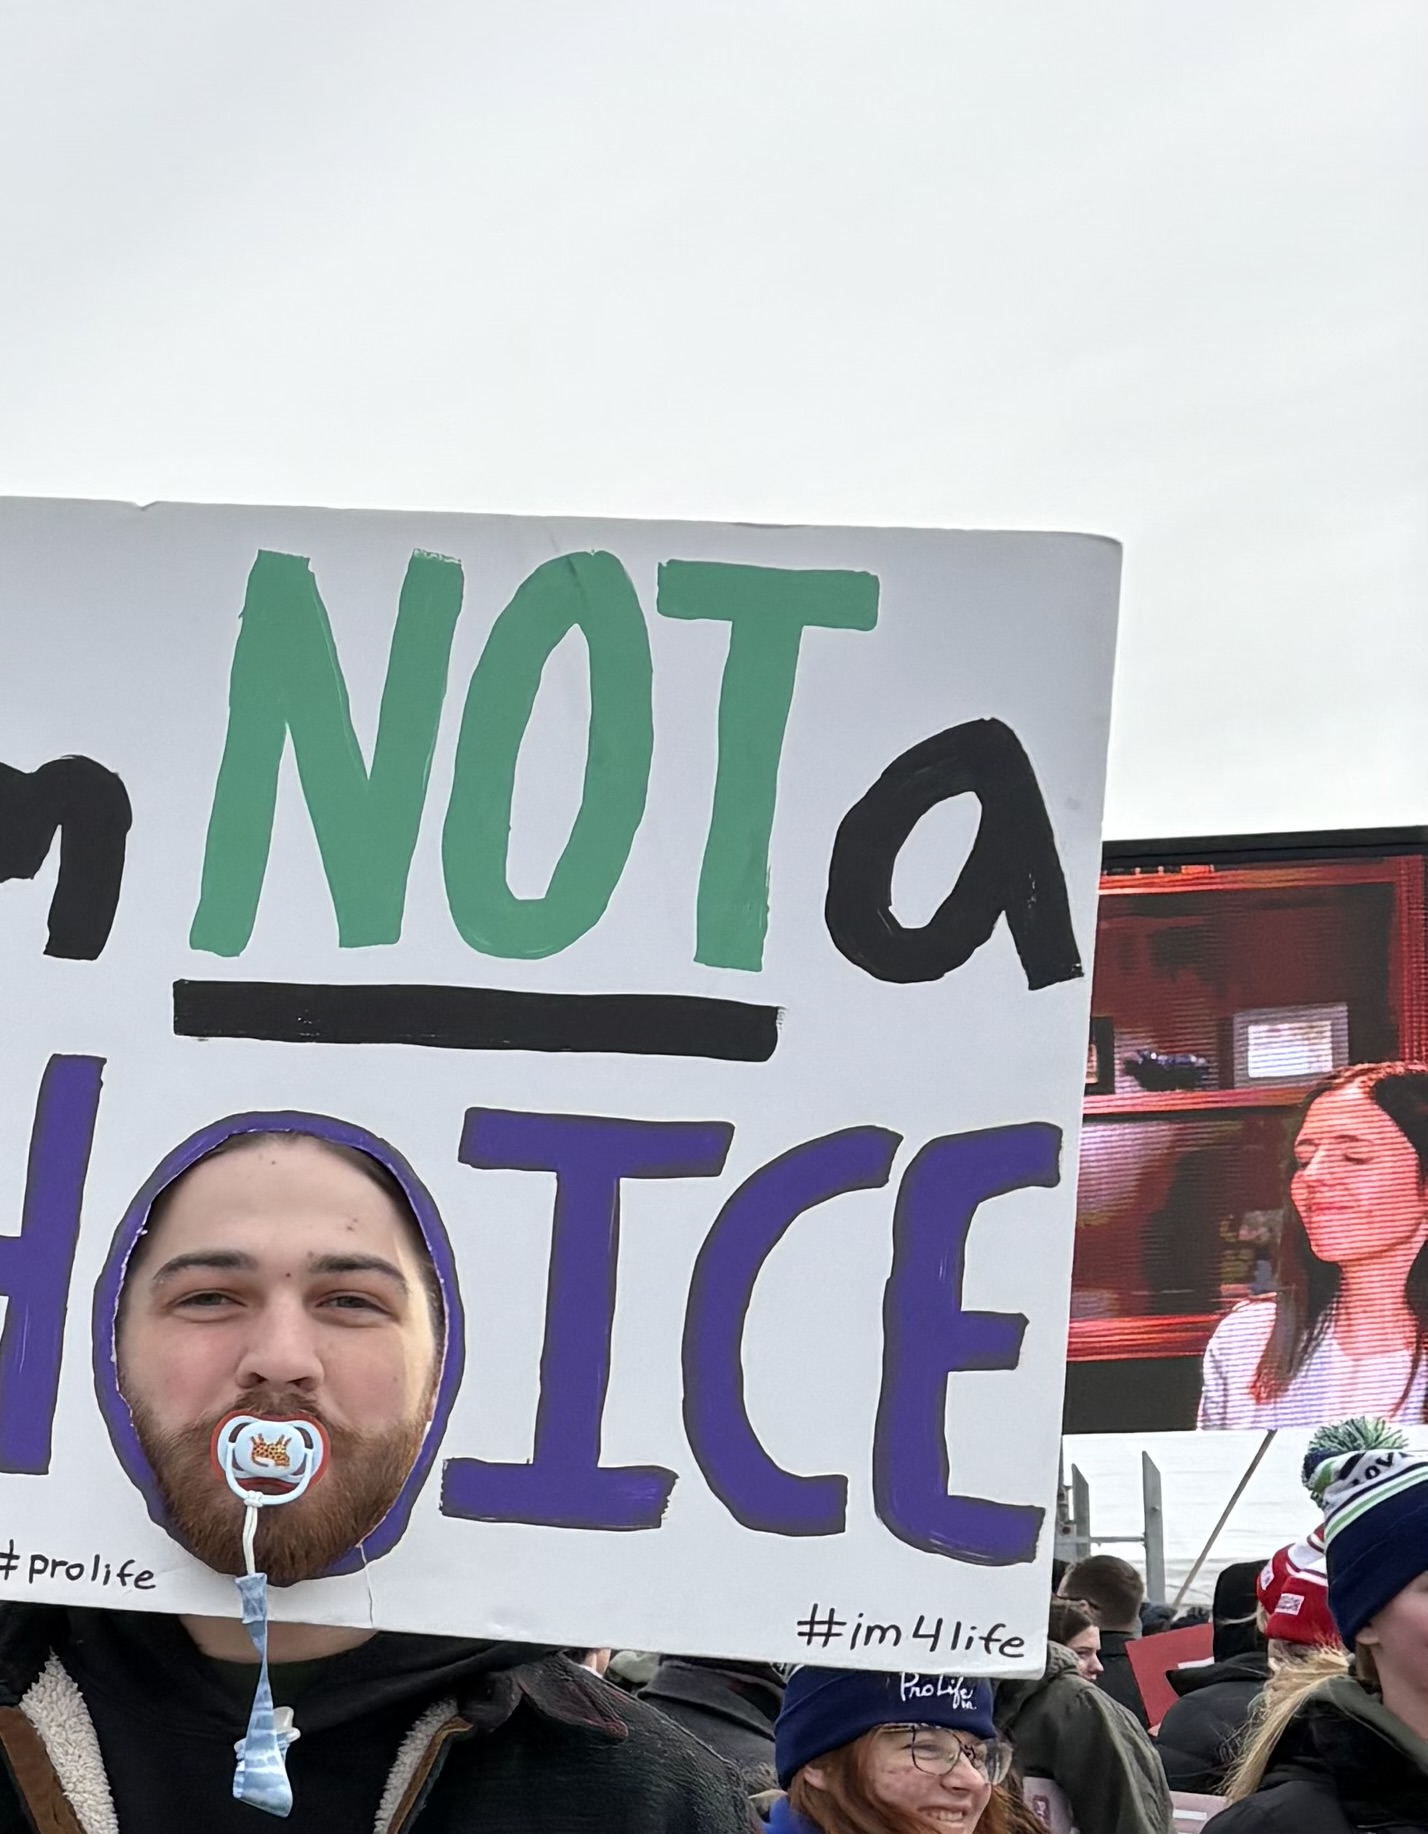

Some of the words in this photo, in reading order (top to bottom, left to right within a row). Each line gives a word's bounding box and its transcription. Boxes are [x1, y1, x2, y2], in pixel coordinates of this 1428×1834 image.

[189, 550, 880, 972] NOT
[824, 717, 1084, 990] a
[796, 1602, 1026, 1659] #im4life
